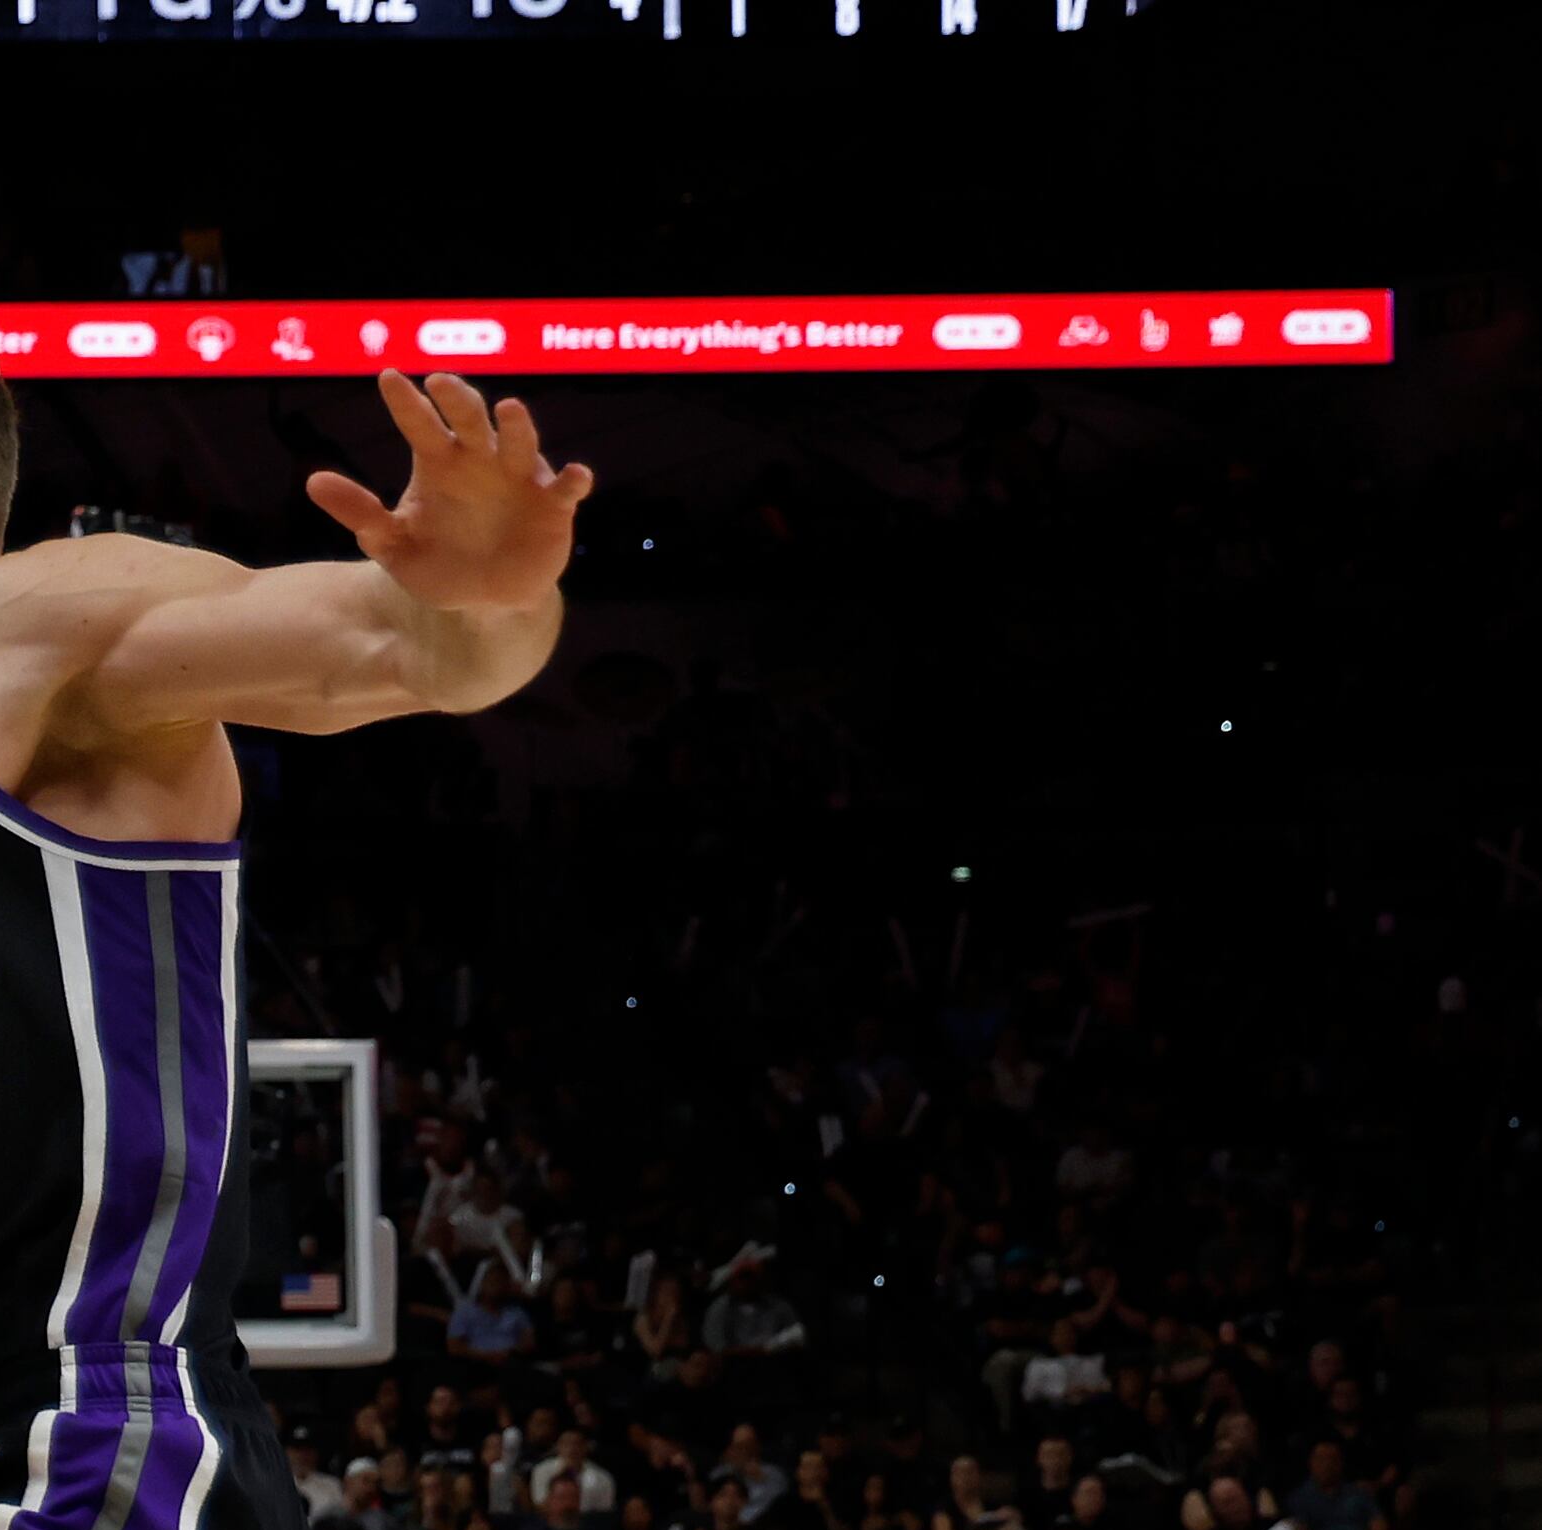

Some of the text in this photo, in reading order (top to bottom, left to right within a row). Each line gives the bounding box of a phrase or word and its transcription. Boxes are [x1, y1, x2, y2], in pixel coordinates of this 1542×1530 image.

[543, 321, 902, 354] Here Everything's Better
